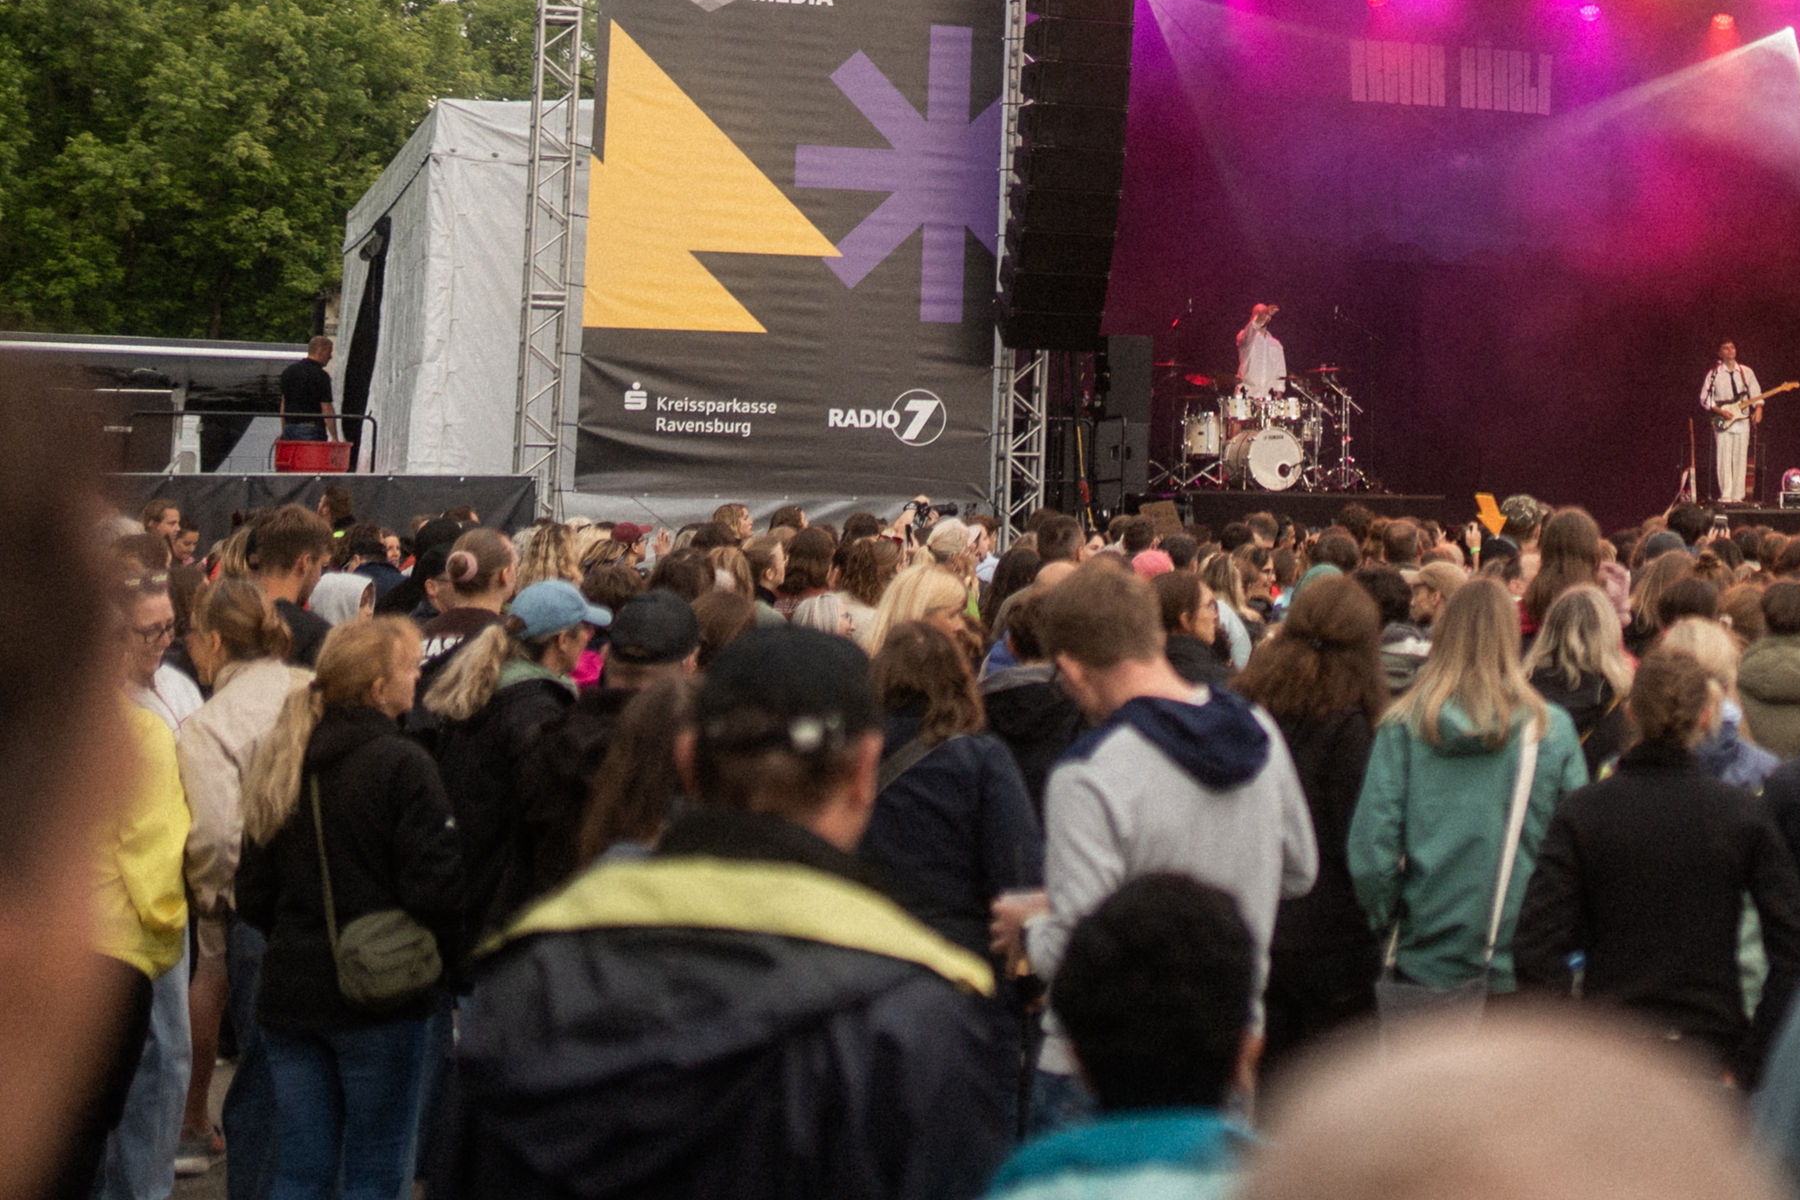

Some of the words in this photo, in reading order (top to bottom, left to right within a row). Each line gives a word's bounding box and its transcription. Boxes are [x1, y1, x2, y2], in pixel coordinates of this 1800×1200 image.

[656, 397, 777, 415] Kreissparkasse
[655, 417, 752, 437] Ravensburg
[828, 408, 900, 428] RADIO
[901, 399, 940, 441] 7
